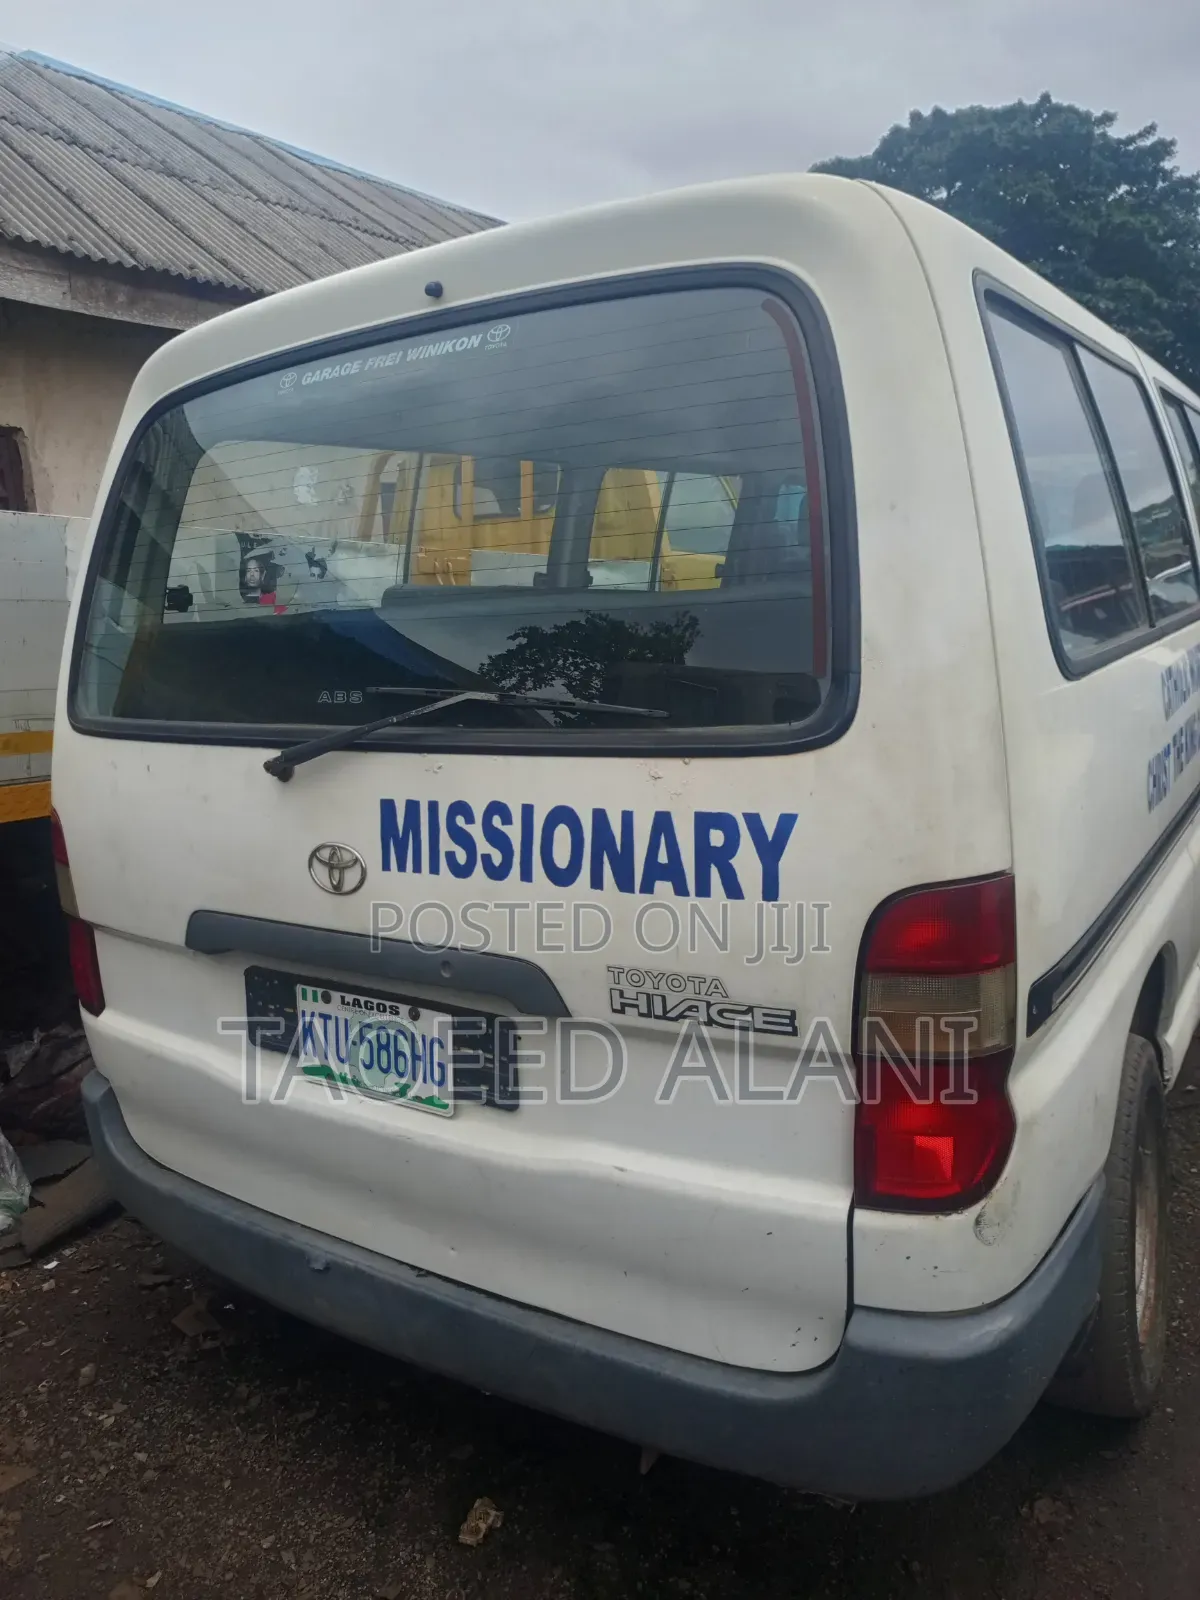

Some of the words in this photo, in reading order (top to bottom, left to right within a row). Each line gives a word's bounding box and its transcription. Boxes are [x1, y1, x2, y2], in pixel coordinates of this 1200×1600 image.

[301, 360, 361, 385] GARAGE
[364, 351, 404, 372] FREI
[406, 333, 484, 362] WINIKON
[317, 690, 363, 704] ABS
[380, 798, 799, 902] MISSIONARY
[607, 966, 729, 998] TOYOTA
[340, 995, 400, 1016] LAGOS
[609, 988, 799, 1037] HIACE
